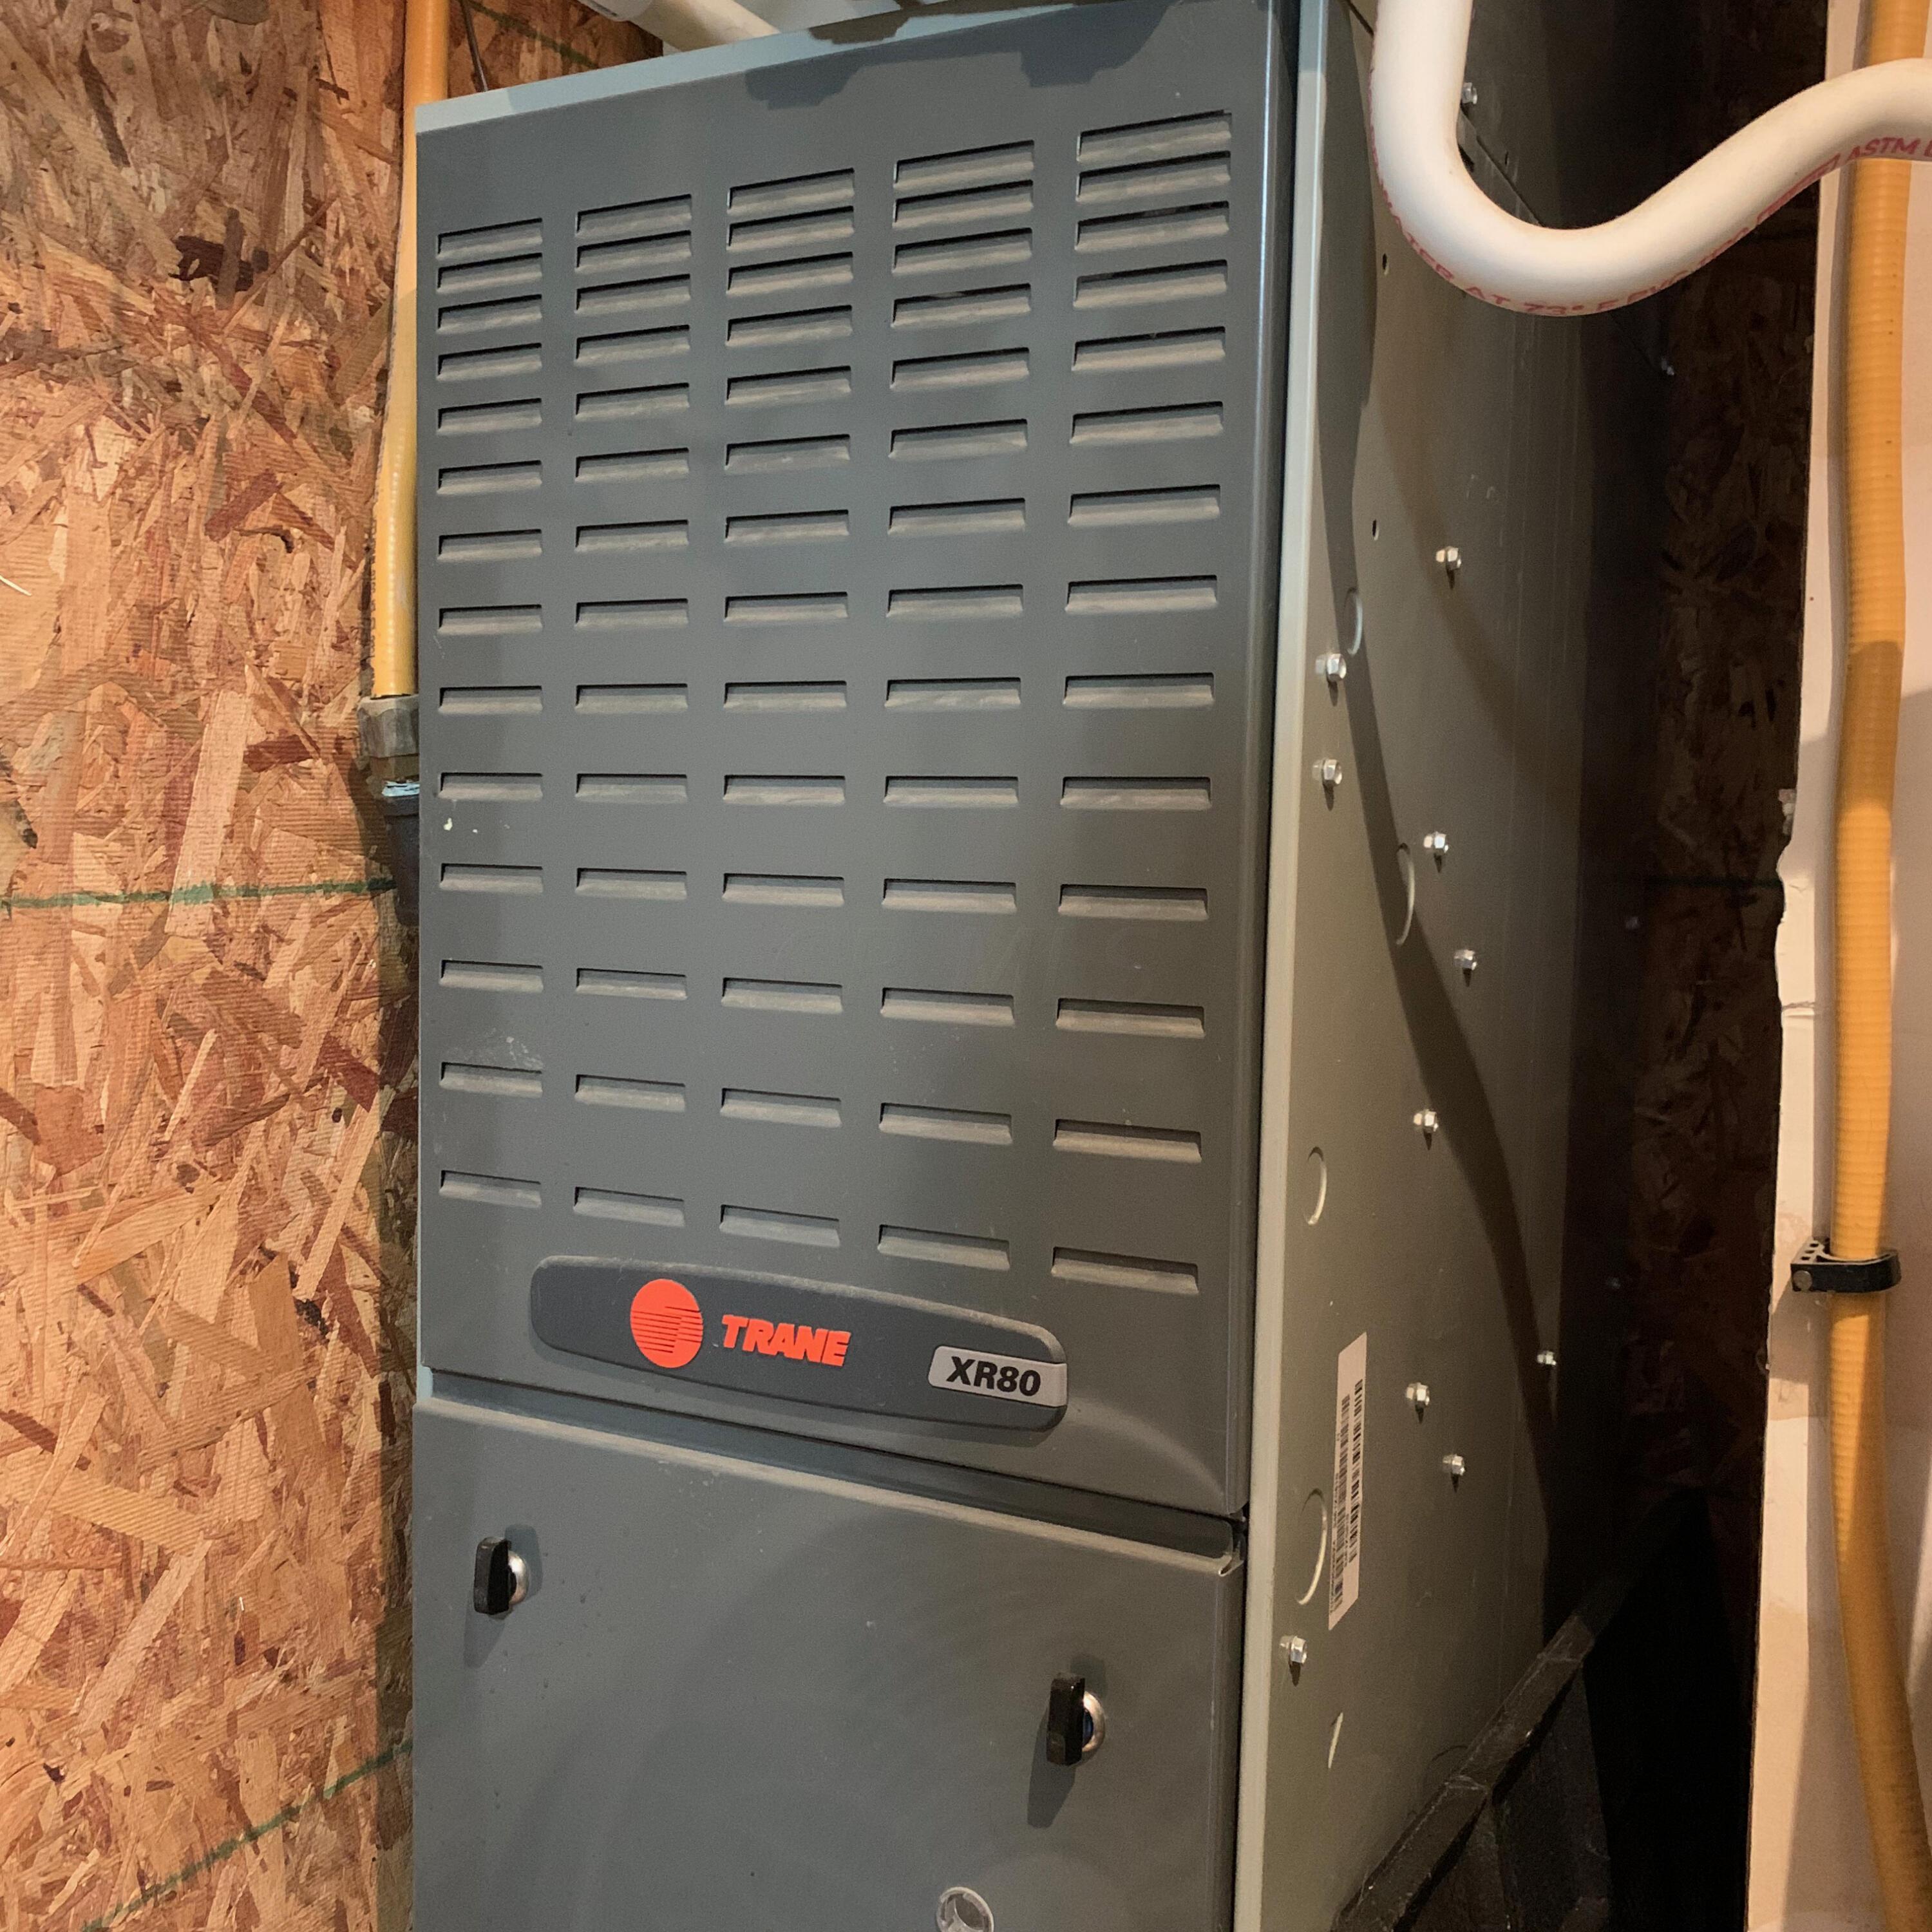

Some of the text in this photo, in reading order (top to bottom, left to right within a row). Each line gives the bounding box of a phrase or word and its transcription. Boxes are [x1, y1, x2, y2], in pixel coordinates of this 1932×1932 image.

[1845, 137, 1921, 162] ASTM
[721, 1314, 851, 1367] TRANE
[946, 1356, 1041, 1397] XR80
